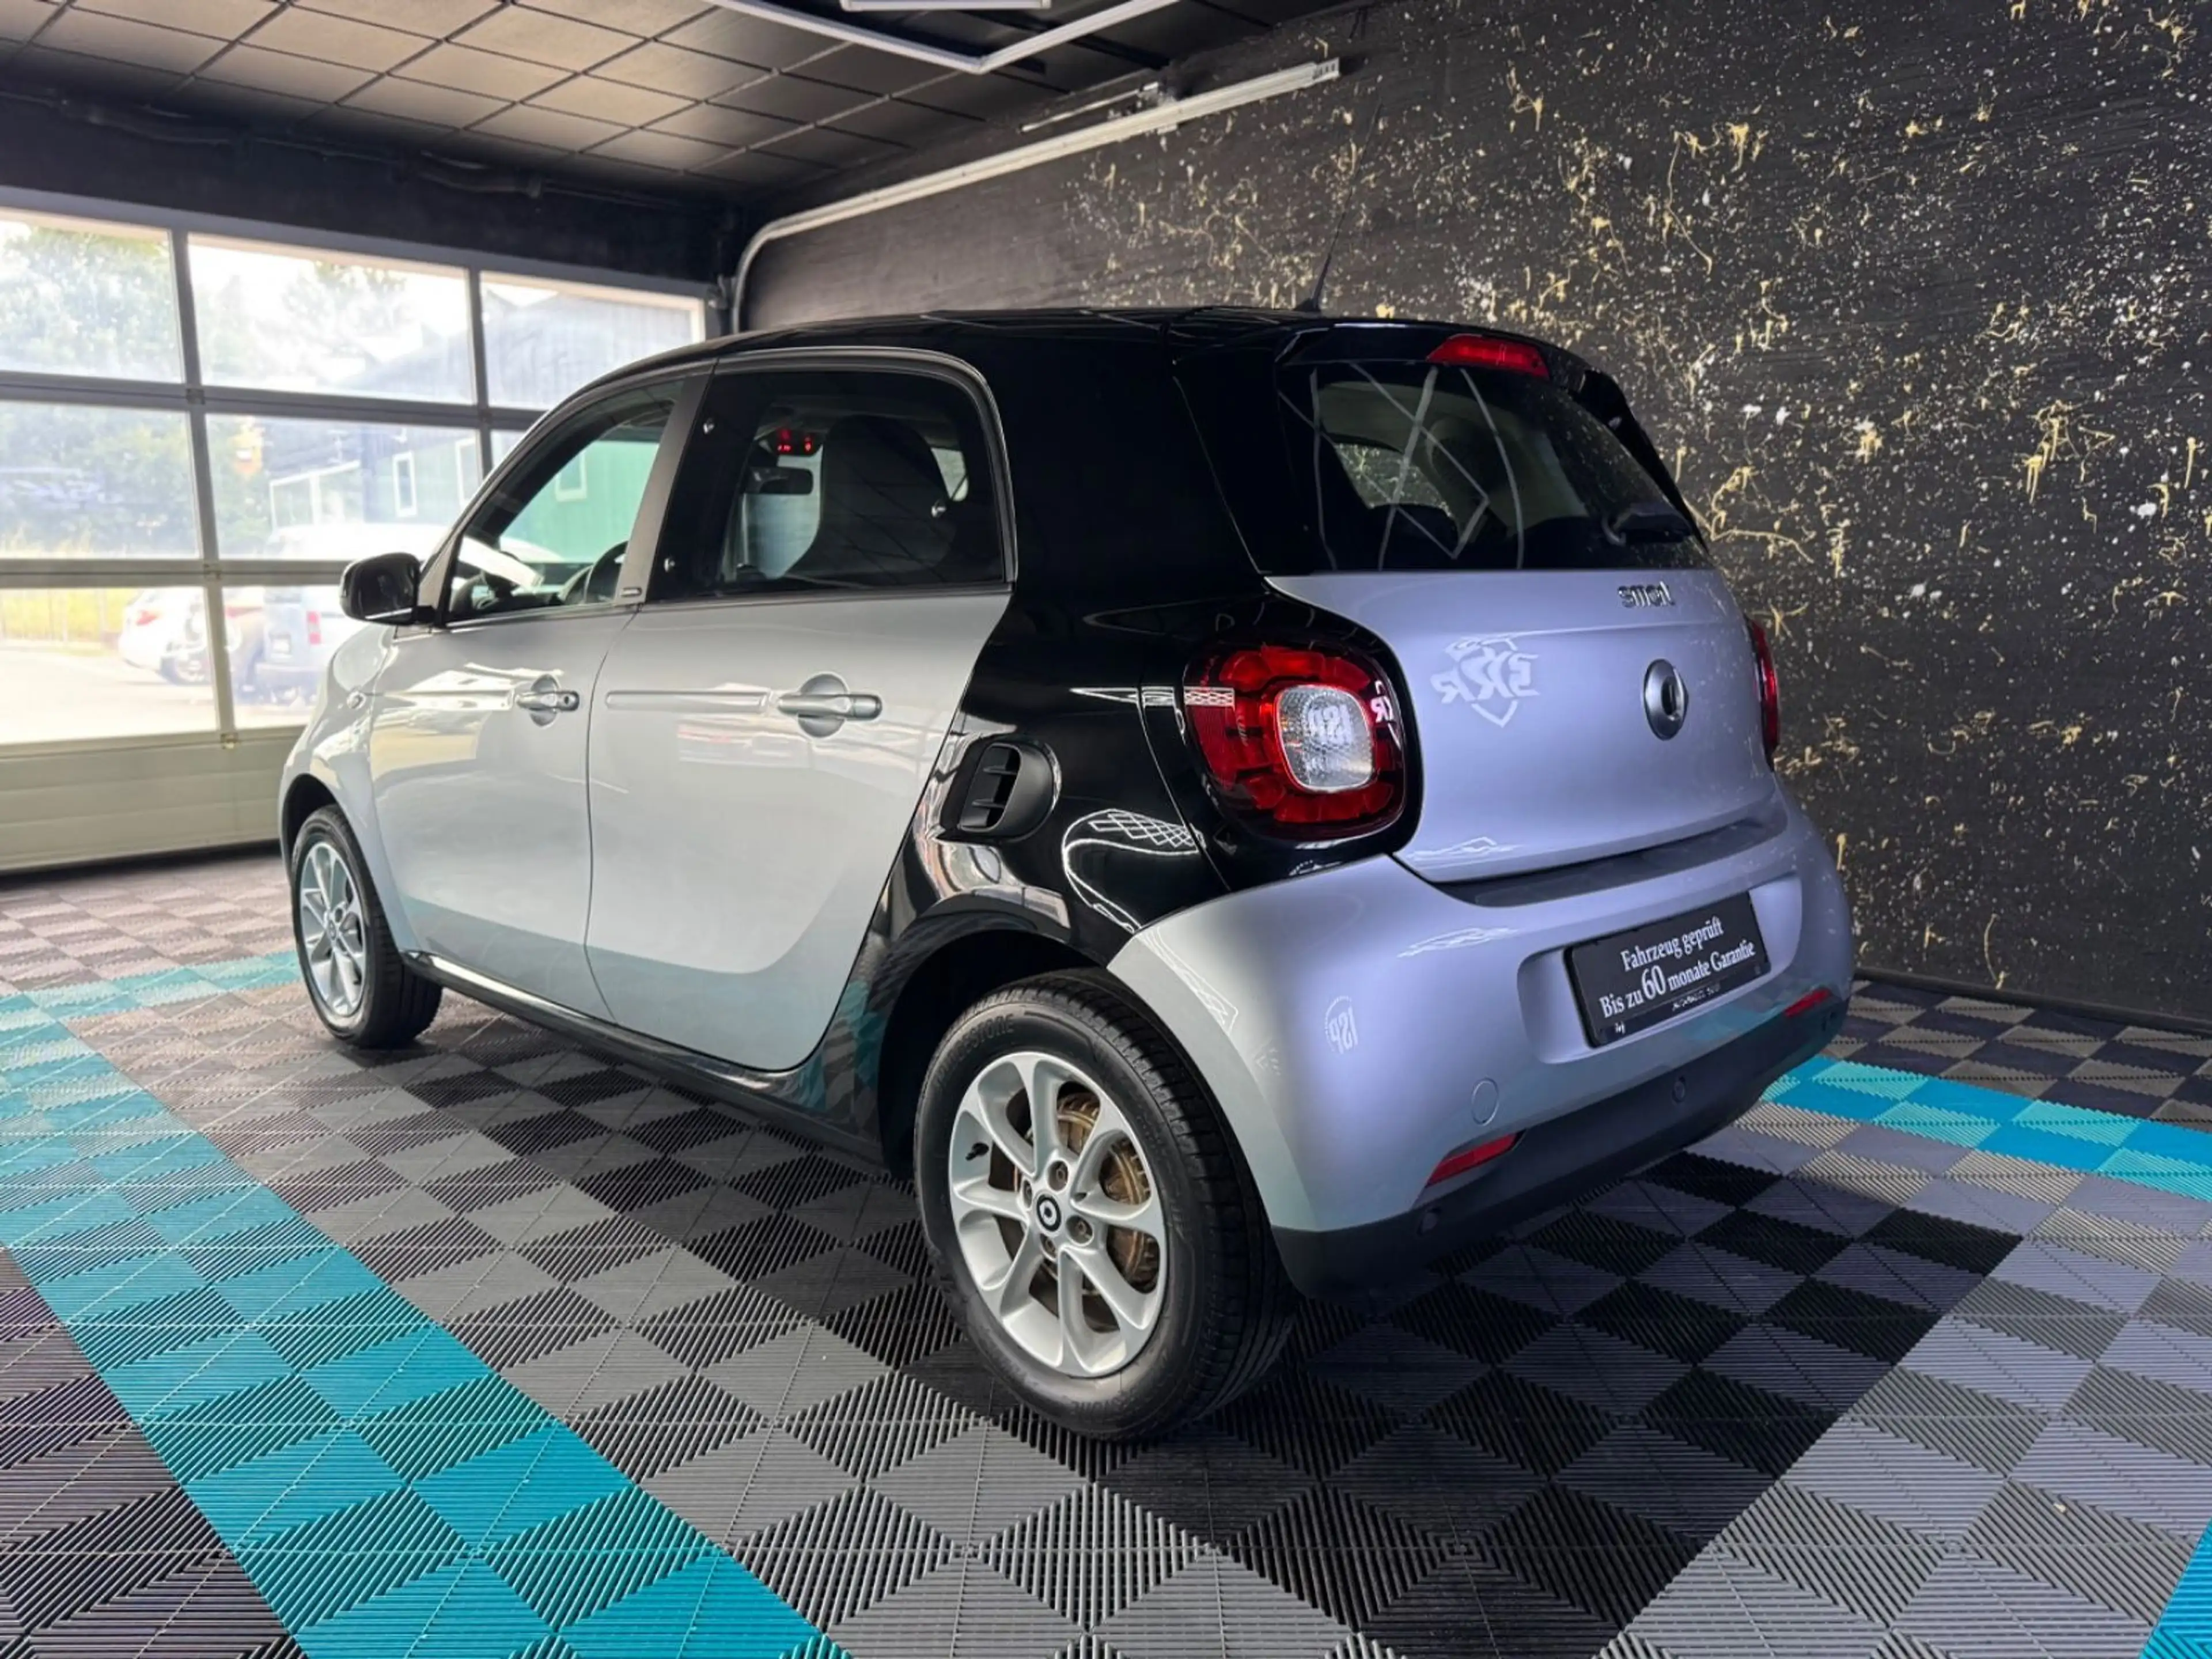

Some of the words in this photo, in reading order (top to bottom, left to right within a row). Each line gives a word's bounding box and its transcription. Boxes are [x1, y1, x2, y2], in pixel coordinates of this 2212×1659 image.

[1620, 938, 1683, 972] Fahrzeug
[1682, 916, 1724, 955] geprüft
[1599, 995, 1624, 1018] Bis
[1627, 988, 1644, 1008] zu
[1642, 965, 1666, 1000] 60
[1667, 960, 1711, 991] monate
[1710, 939, 1756, 972] Garantie
